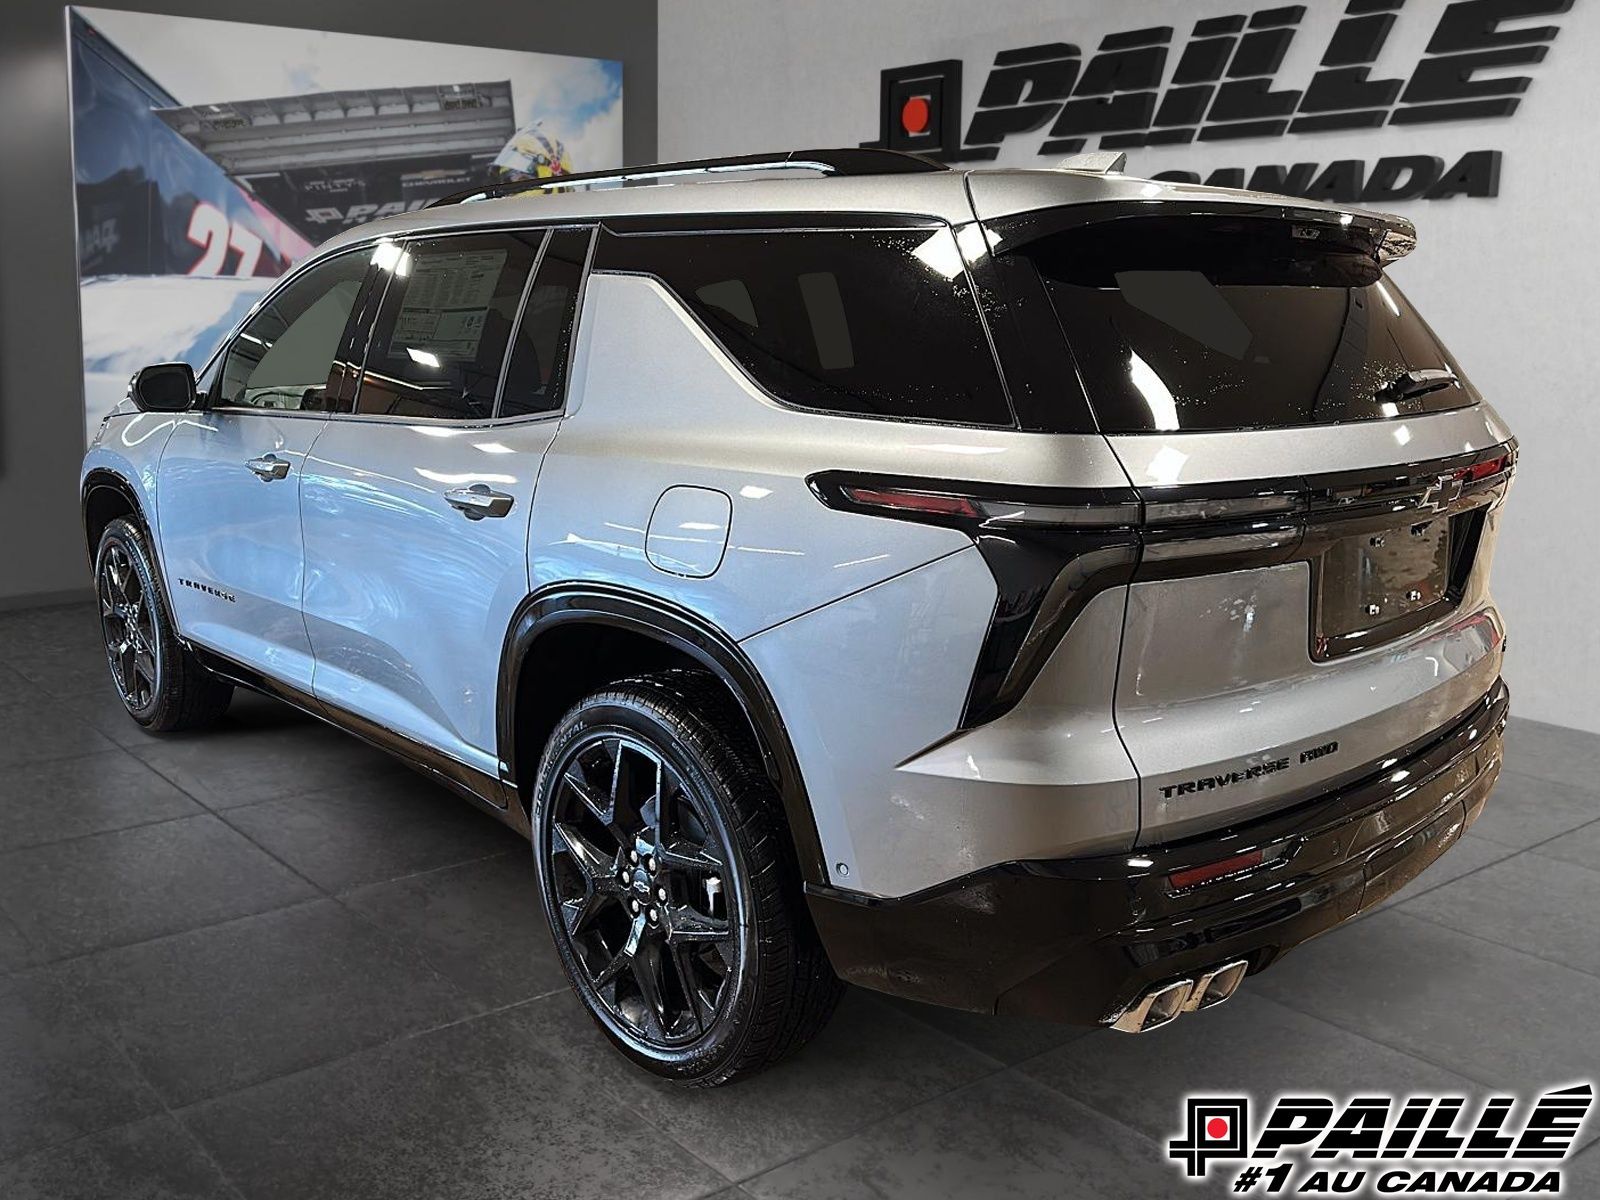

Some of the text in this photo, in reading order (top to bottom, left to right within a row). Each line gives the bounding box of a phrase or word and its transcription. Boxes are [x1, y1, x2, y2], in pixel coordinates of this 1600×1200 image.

[187, 202, 263, 277] 27
[178, 578, 236, 603] TRAVERSE
[1159, 757, 1290, 798] TRAVERSE
